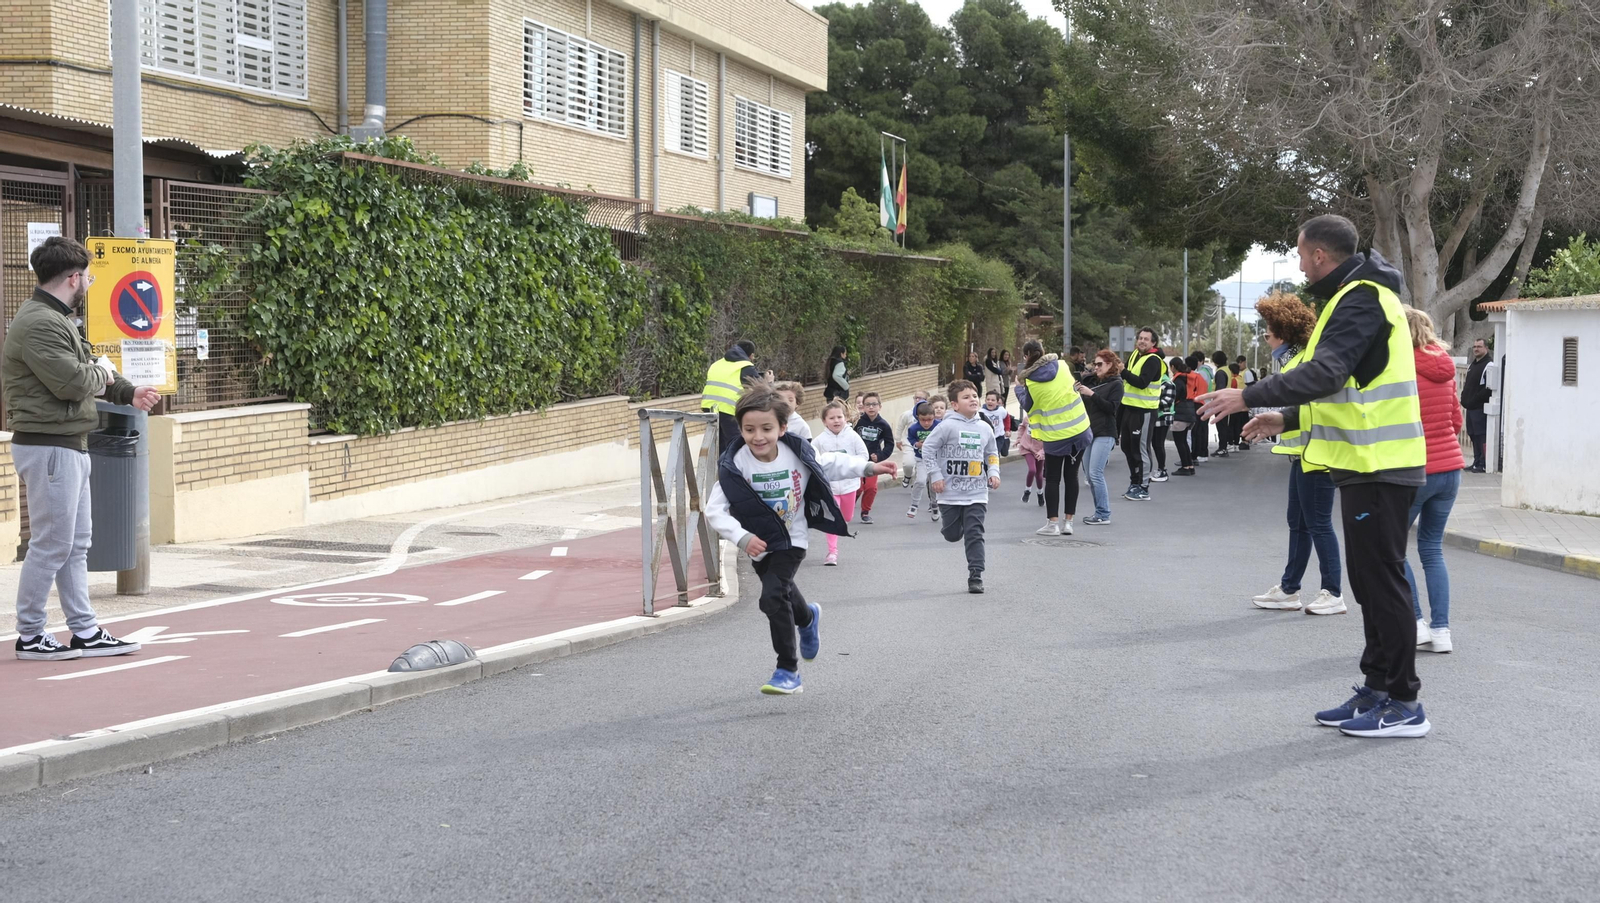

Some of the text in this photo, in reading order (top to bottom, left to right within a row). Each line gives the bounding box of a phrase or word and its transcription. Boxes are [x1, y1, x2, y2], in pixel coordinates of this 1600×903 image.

[138, 247, 173, 256] AYUNTAMIENTO
[131, 256, 139, 264] DE
[91, 344, 121, 354] ESTACIO
[763, 481, 781, 491] 069
